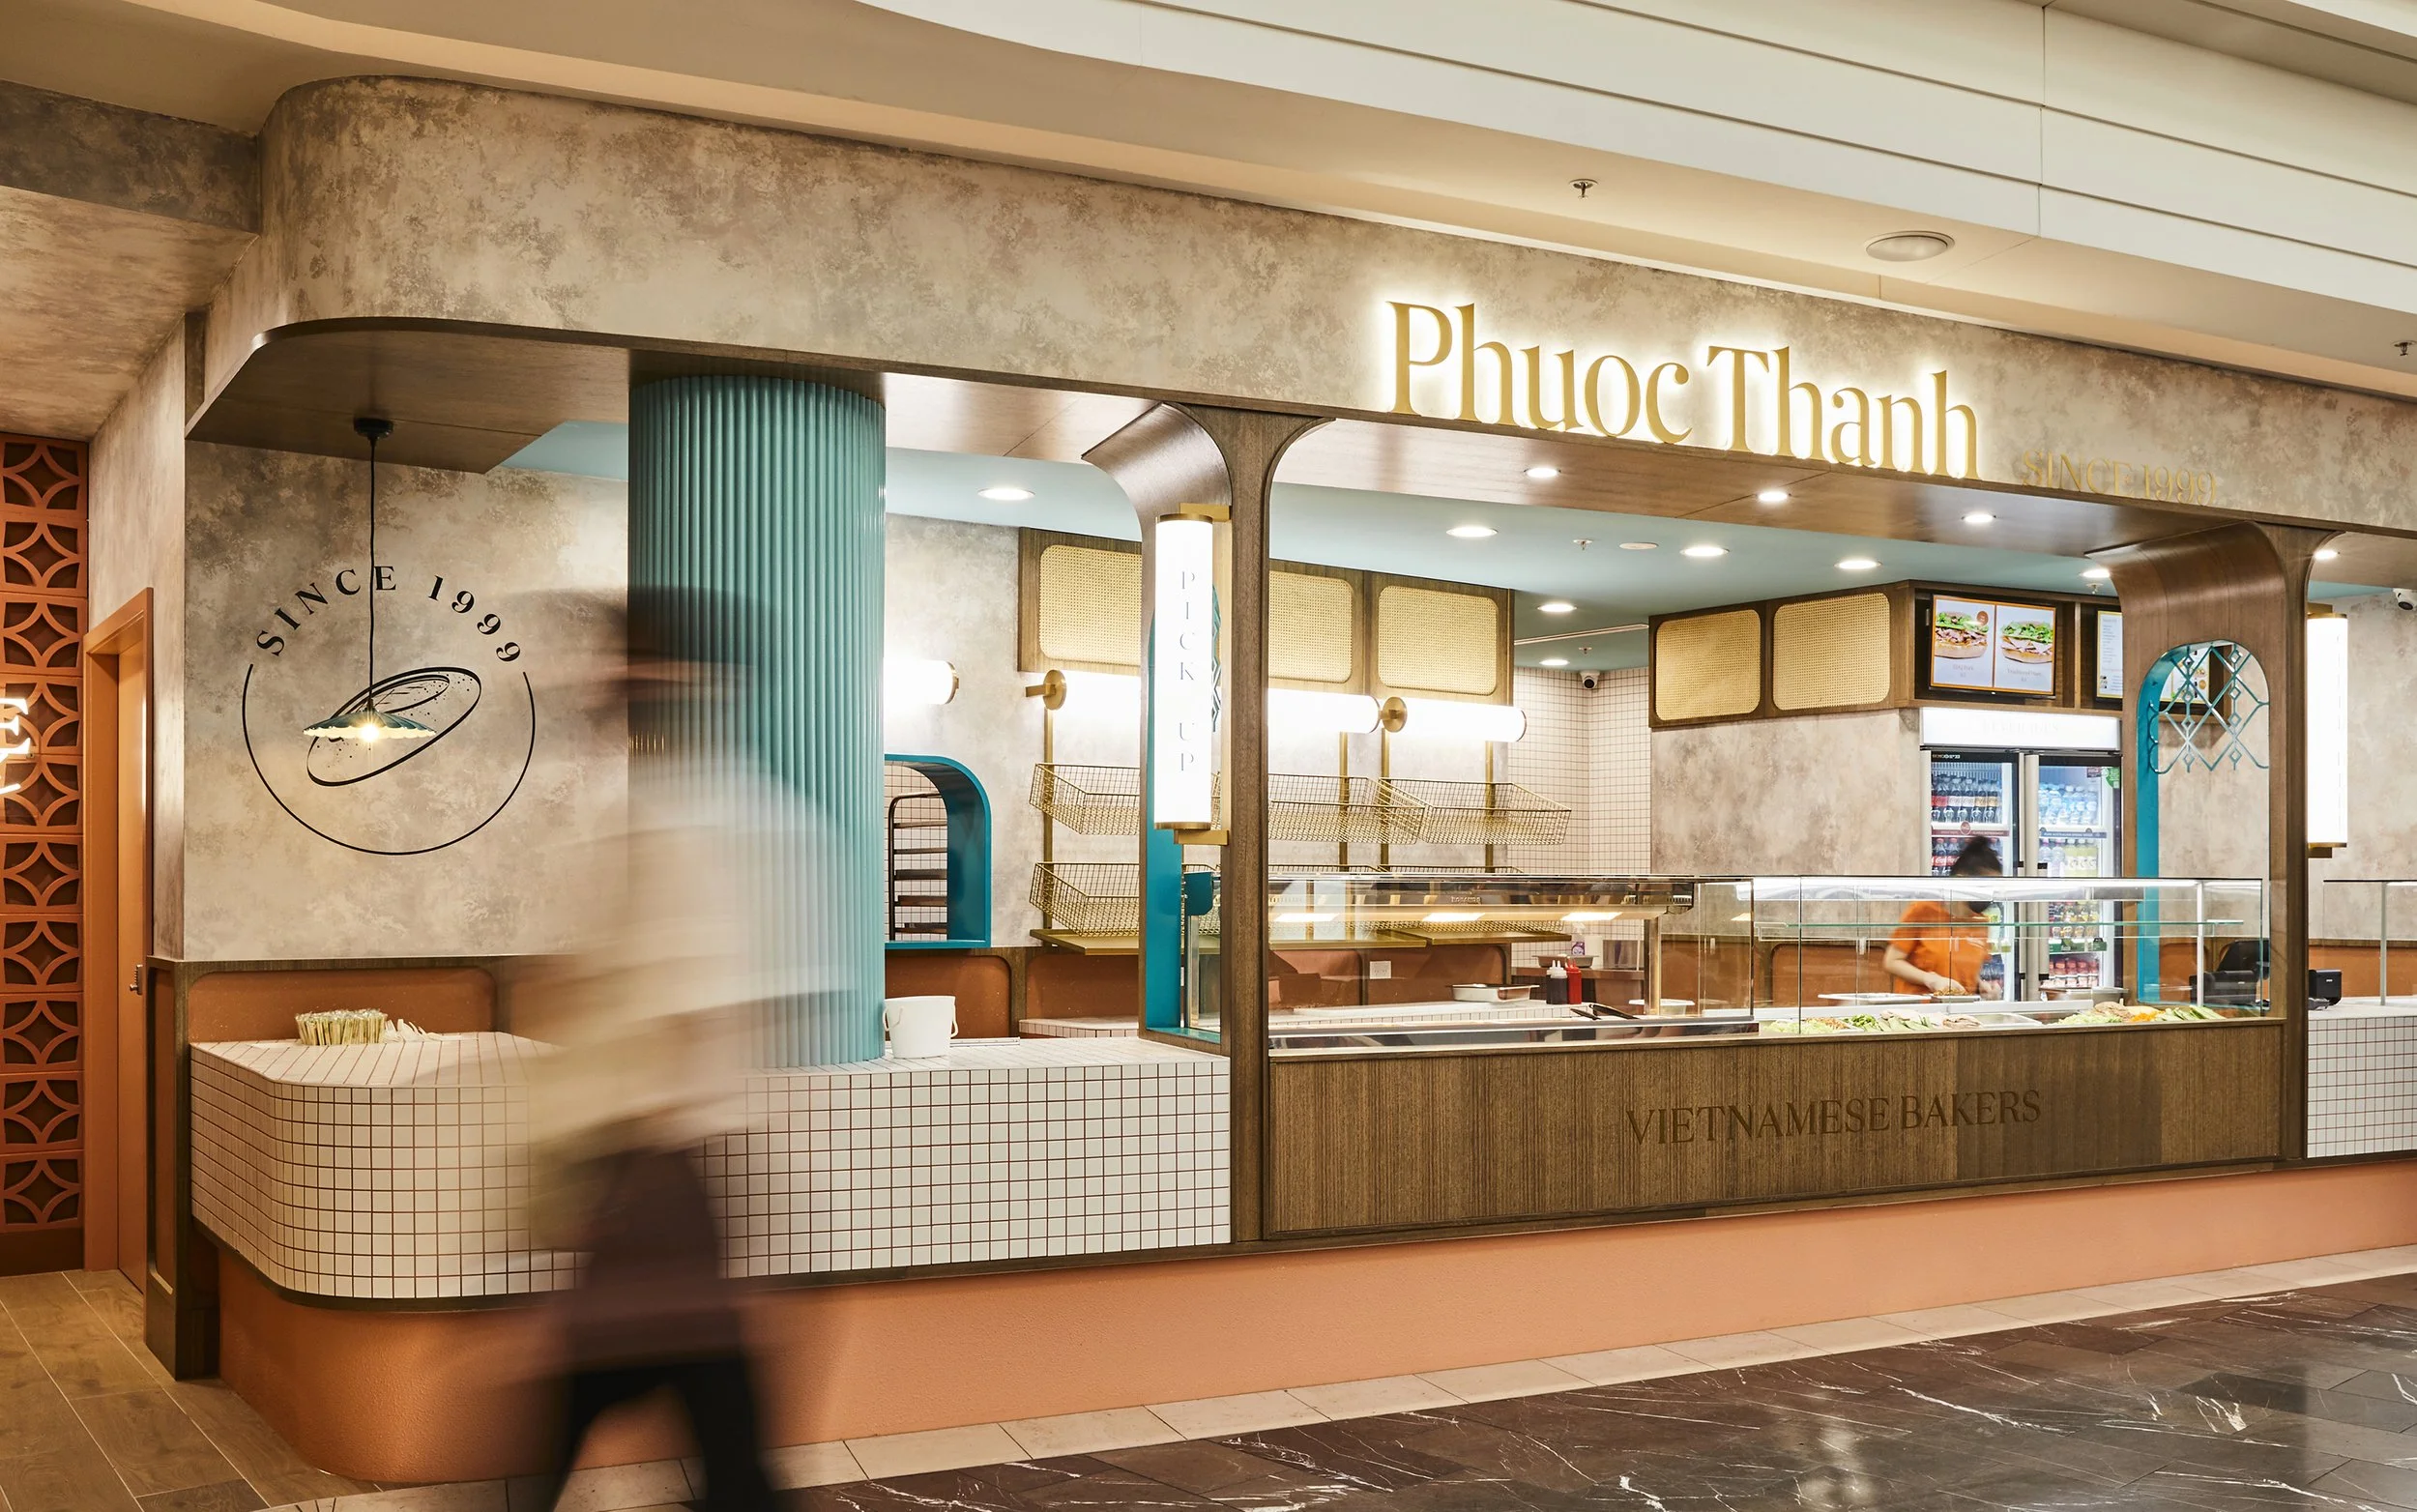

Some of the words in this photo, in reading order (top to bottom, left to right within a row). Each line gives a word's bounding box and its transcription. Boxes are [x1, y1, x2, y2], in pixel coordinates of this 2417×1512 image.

[1385, 301, 1692, 444] Phuoc
[1706, 345, 1983, 480] Thanh
[2022, 449, 2135, 499] SINCE
[2142, 463, 2217, 506] 1999
[256, 566, 396, 656] SINCE
[428, 575, 520, 662] 1999
[1179, 571, 1196, 680] PICK
[1179, 722, 1195, 771] UP
[1626, 1096, 1891, 1145] VIETNAMESE
[1900, 1089, 2042, 1129] BAKERS
